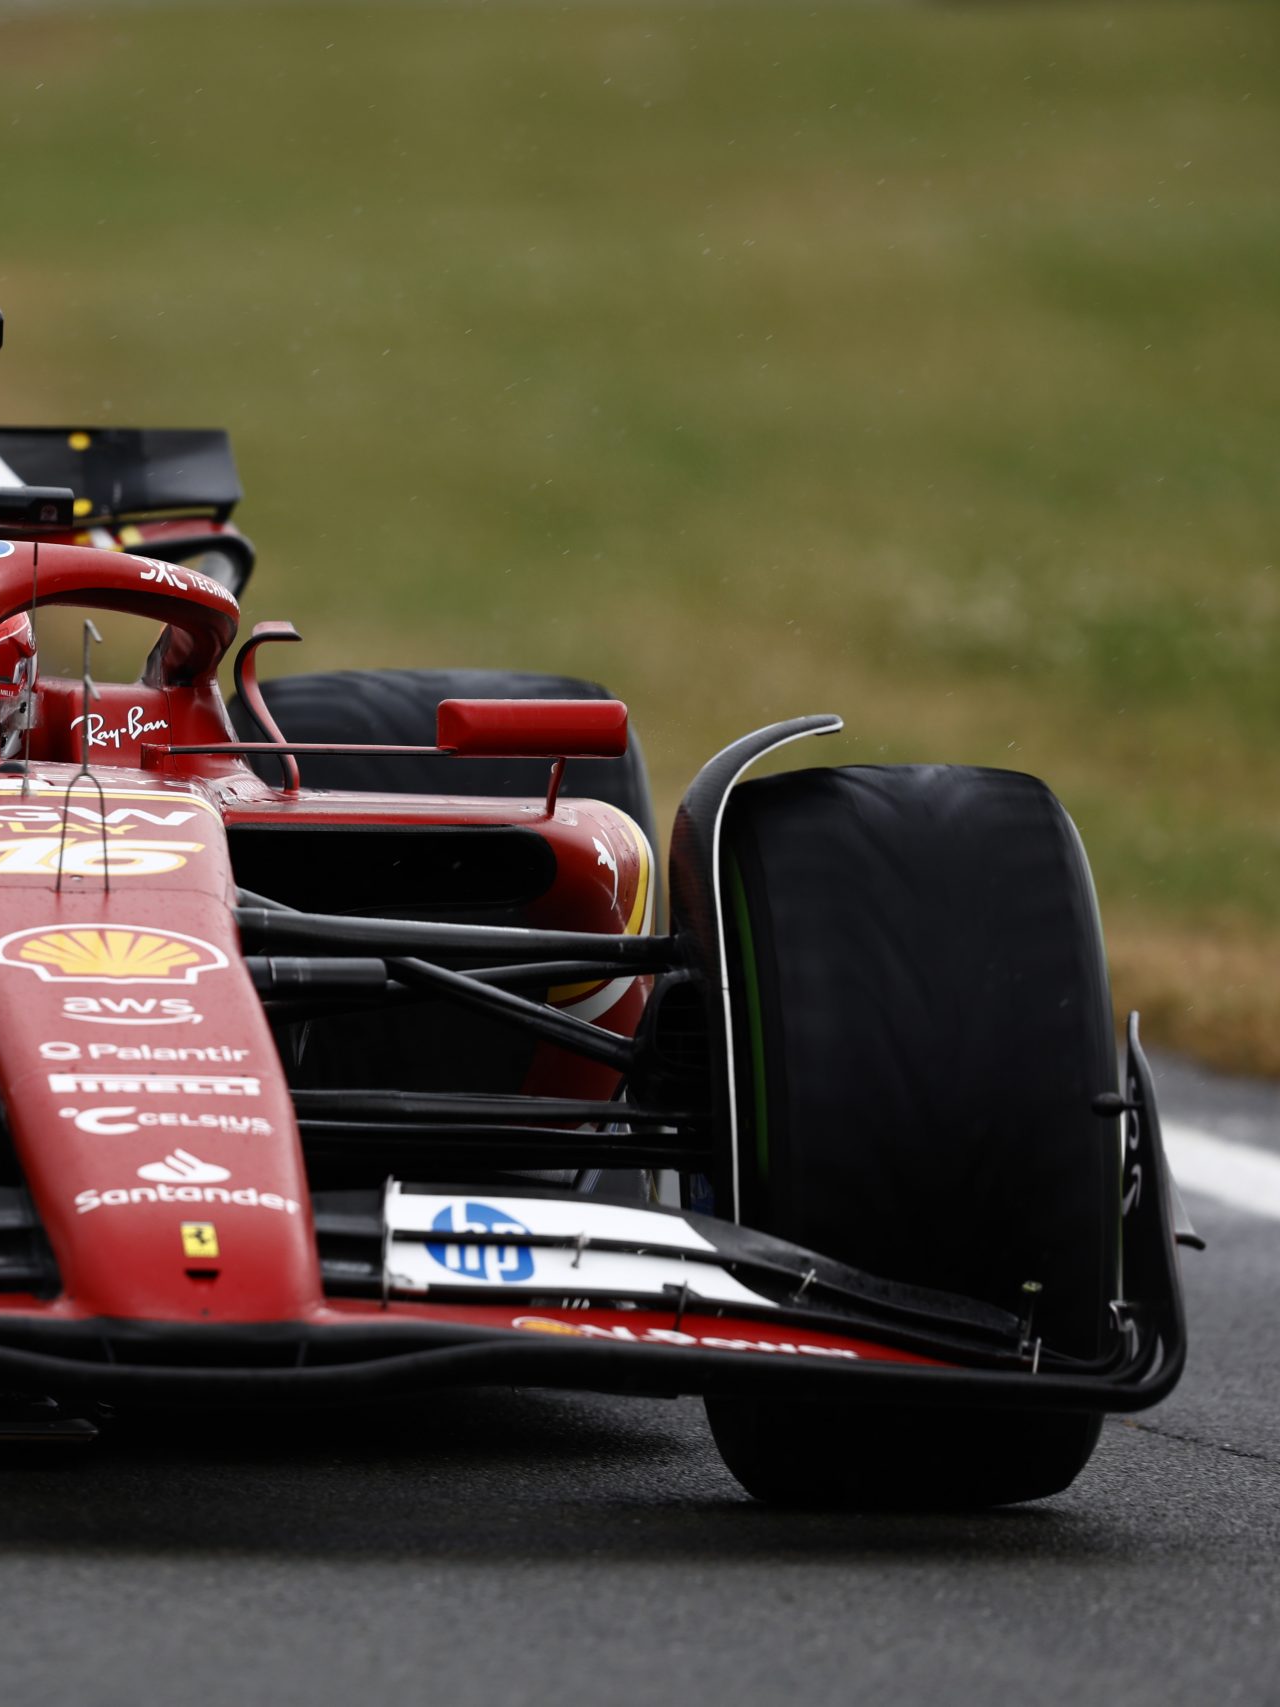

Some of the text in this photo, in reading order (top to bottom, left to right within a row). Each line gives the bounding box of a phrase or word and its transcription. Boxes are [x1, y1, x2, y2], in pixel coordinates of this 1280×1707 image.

[87, 1043, 250, 1062] Palantir
[47, 1073, 261, 1097] PIRELLI
[137, 1112, 273, 1133] CELSIUS
[74, 1182, 301, 1215] Santander
[444, 1202, 528, 1282] hp
